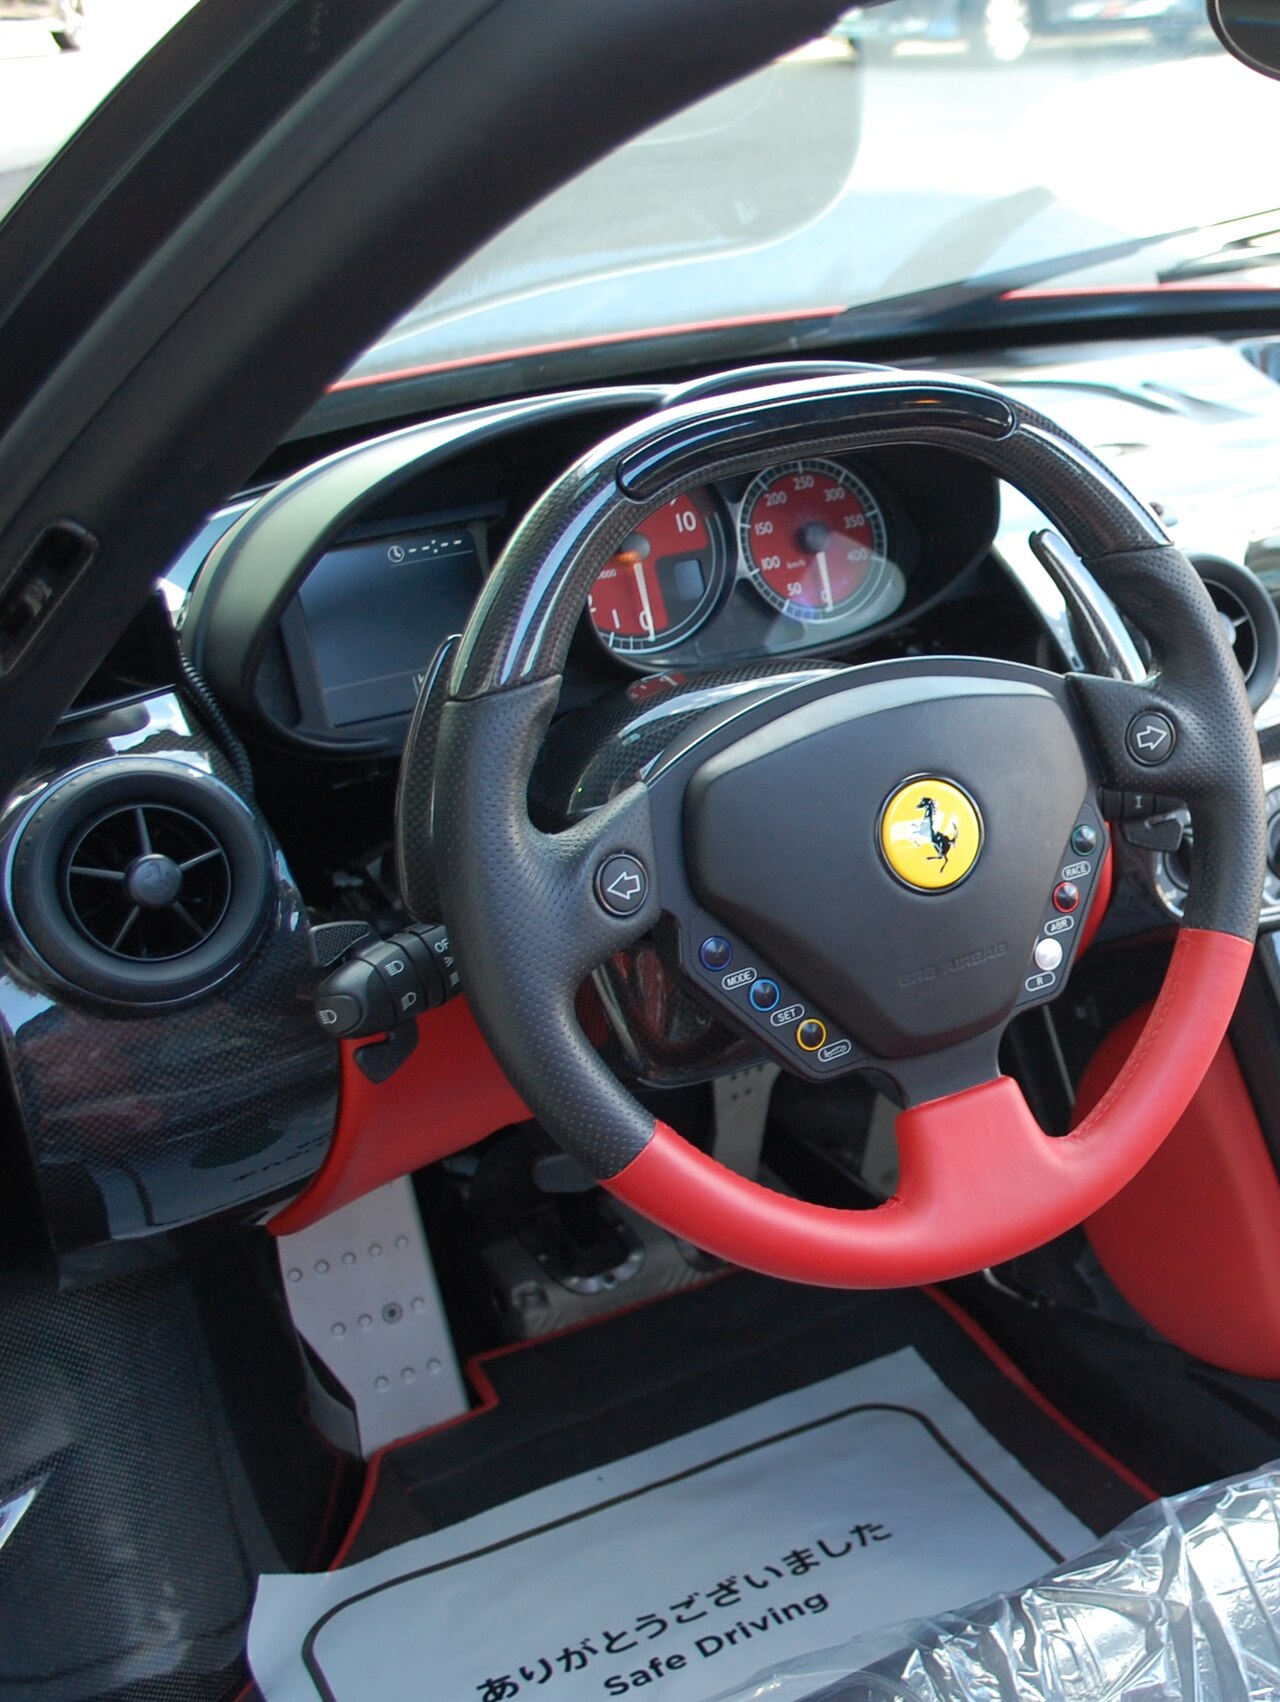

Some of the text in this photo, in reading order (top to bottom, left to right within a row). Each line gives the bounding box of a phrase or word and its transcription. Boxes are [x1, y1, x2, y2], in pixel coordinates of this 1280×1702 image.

[793, 475, 814, 491] 250
[764, 491, 787, 507] 200
[824, 487, 845, 502] 300
[675, 511, 697, 533] 10
[754, 521, 773, 535] 150
[844, 514, 865, 529] 350
[761, 555, 781, 570] 100
[787, 582, 802, 597] 50
[1065, 863, 1087, 877] RACE
[726, 970, 753, 987] MODE
[777, 1008, 797, 1022] SET
[476, 1521, 893, 1702] ありがとうございました
[603, 1590, 830, 1697] Safe Driving
